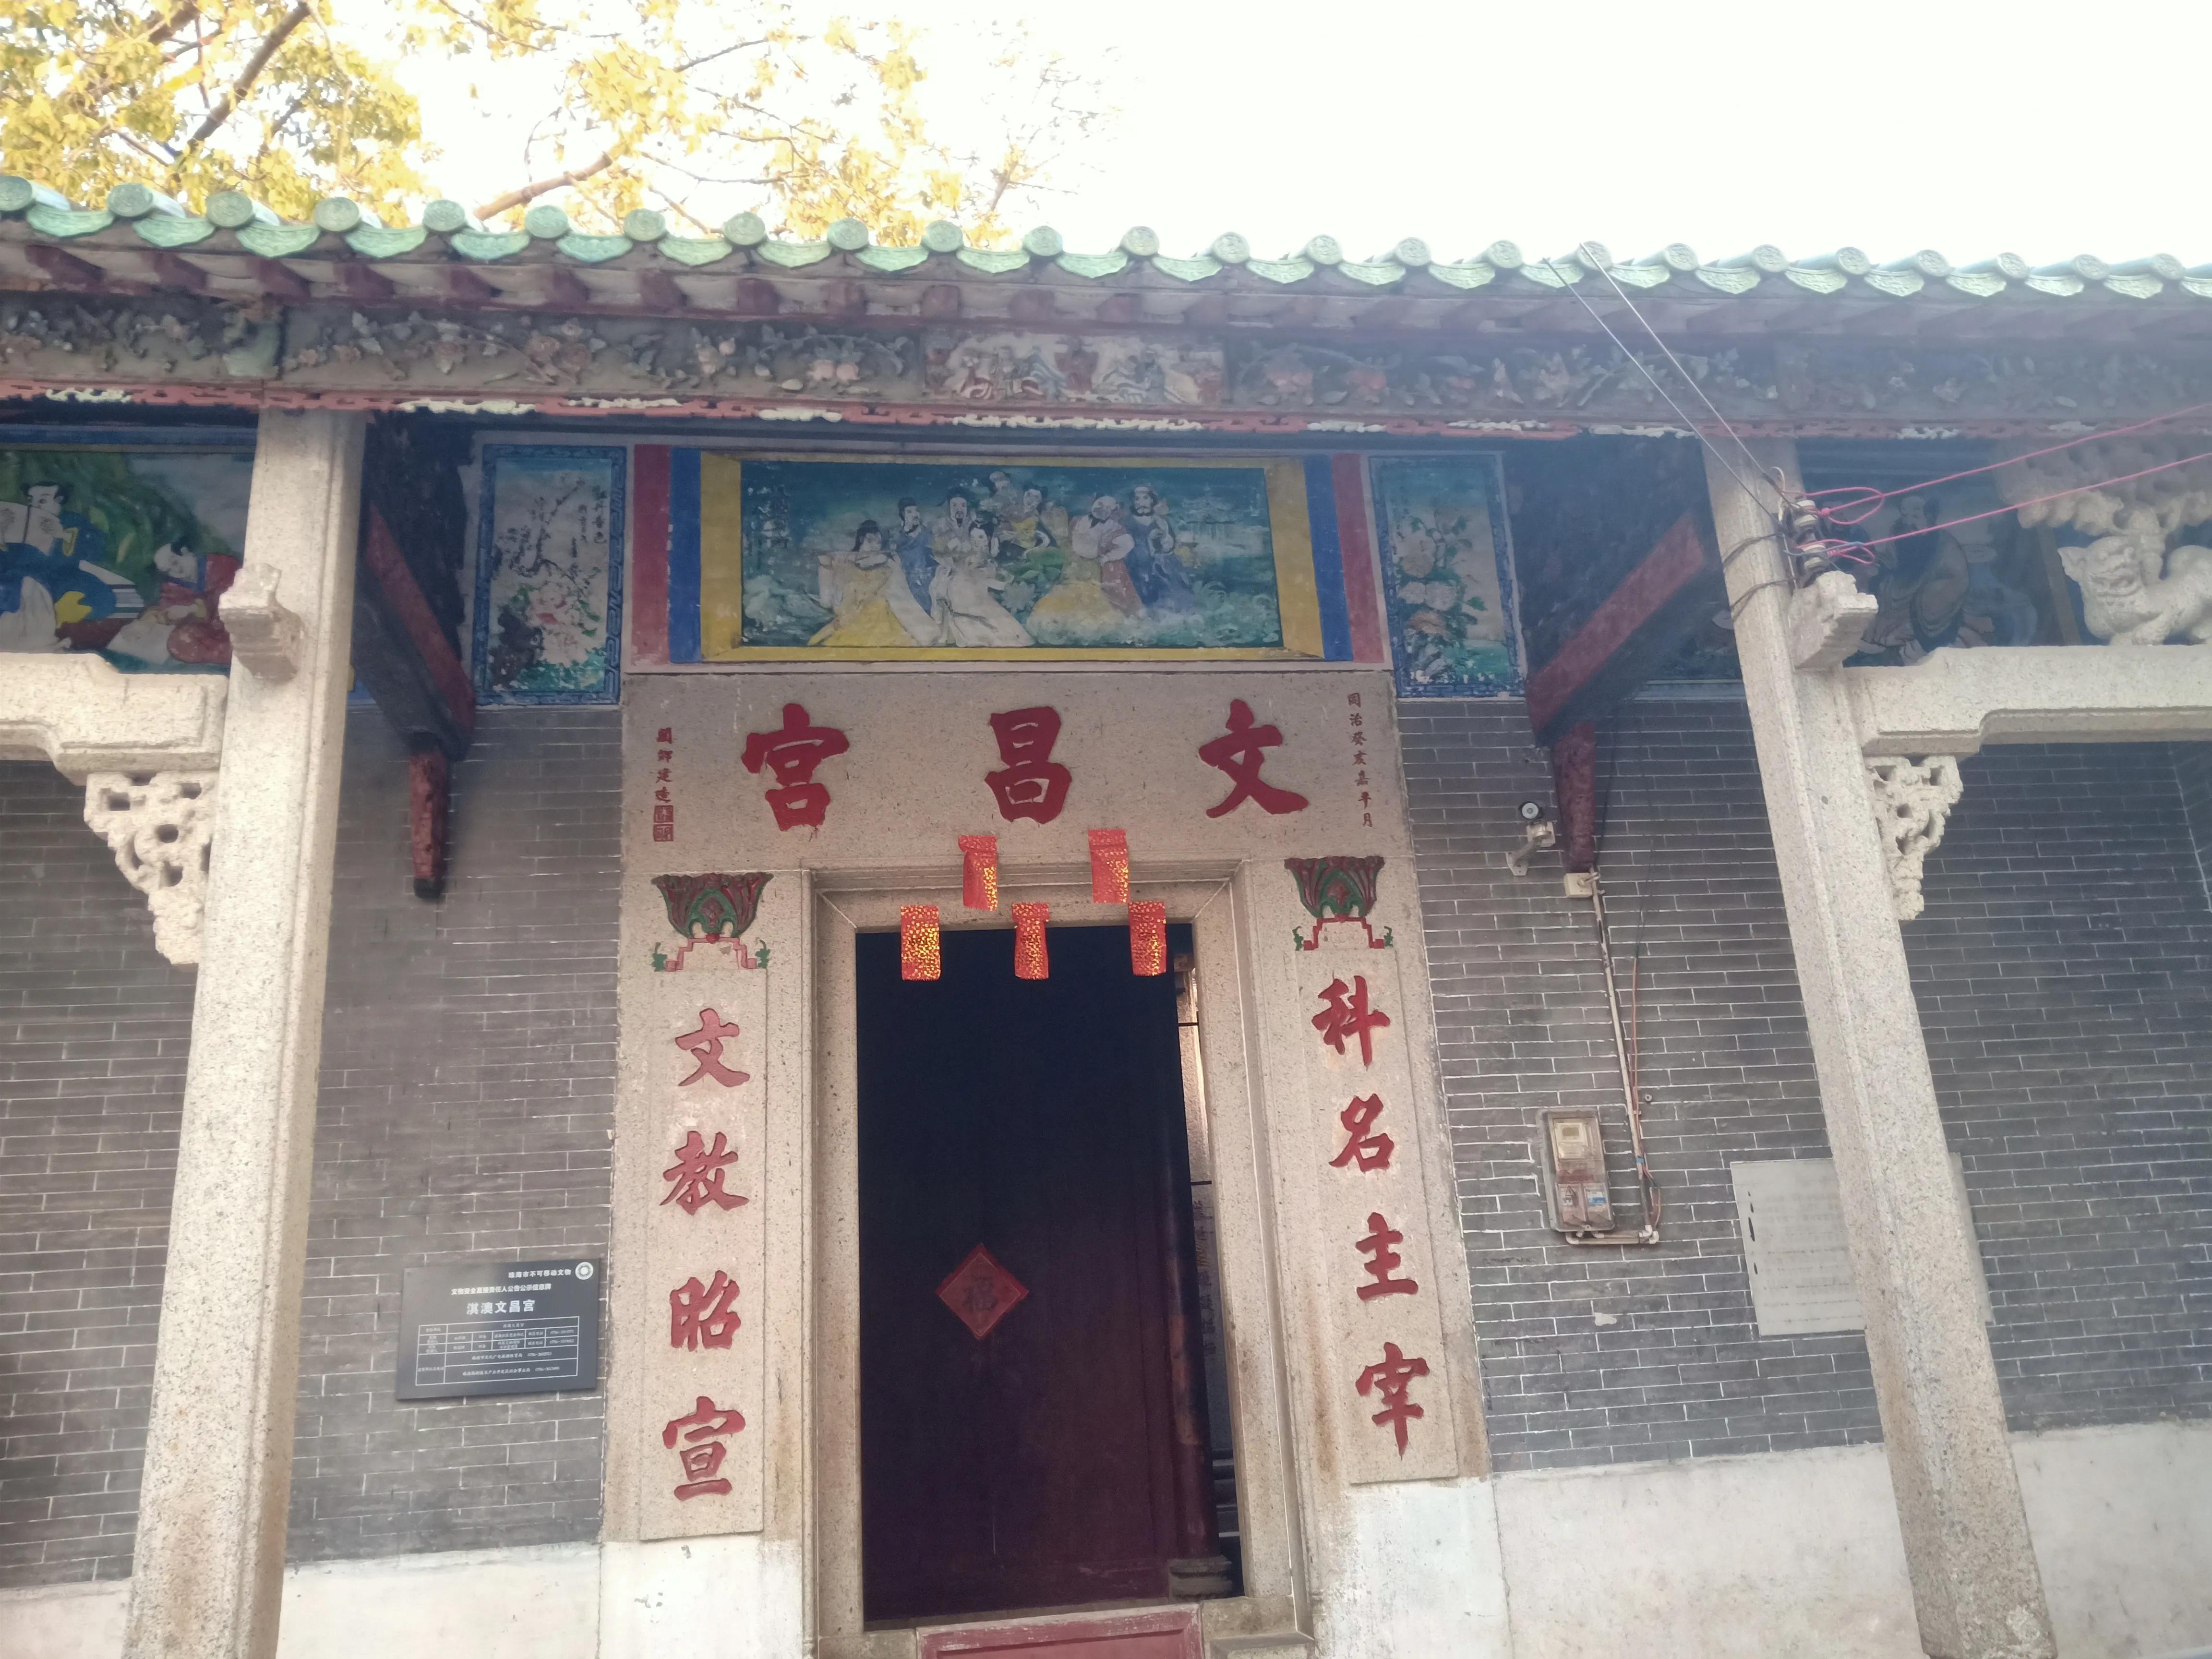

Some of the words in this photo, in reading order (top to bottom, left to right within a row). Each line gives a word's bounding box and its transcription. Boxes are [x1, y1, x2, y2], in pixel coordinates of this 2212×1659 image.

[466, 1299, 535, 1315] 淇澳文昌宫
[508, 1269, 571, 1278] 珠海市不可移动文物
[659, 1008, 750, 1501] 文教昭宣
[1311, 975, 1430, 1461] 科名主宰
